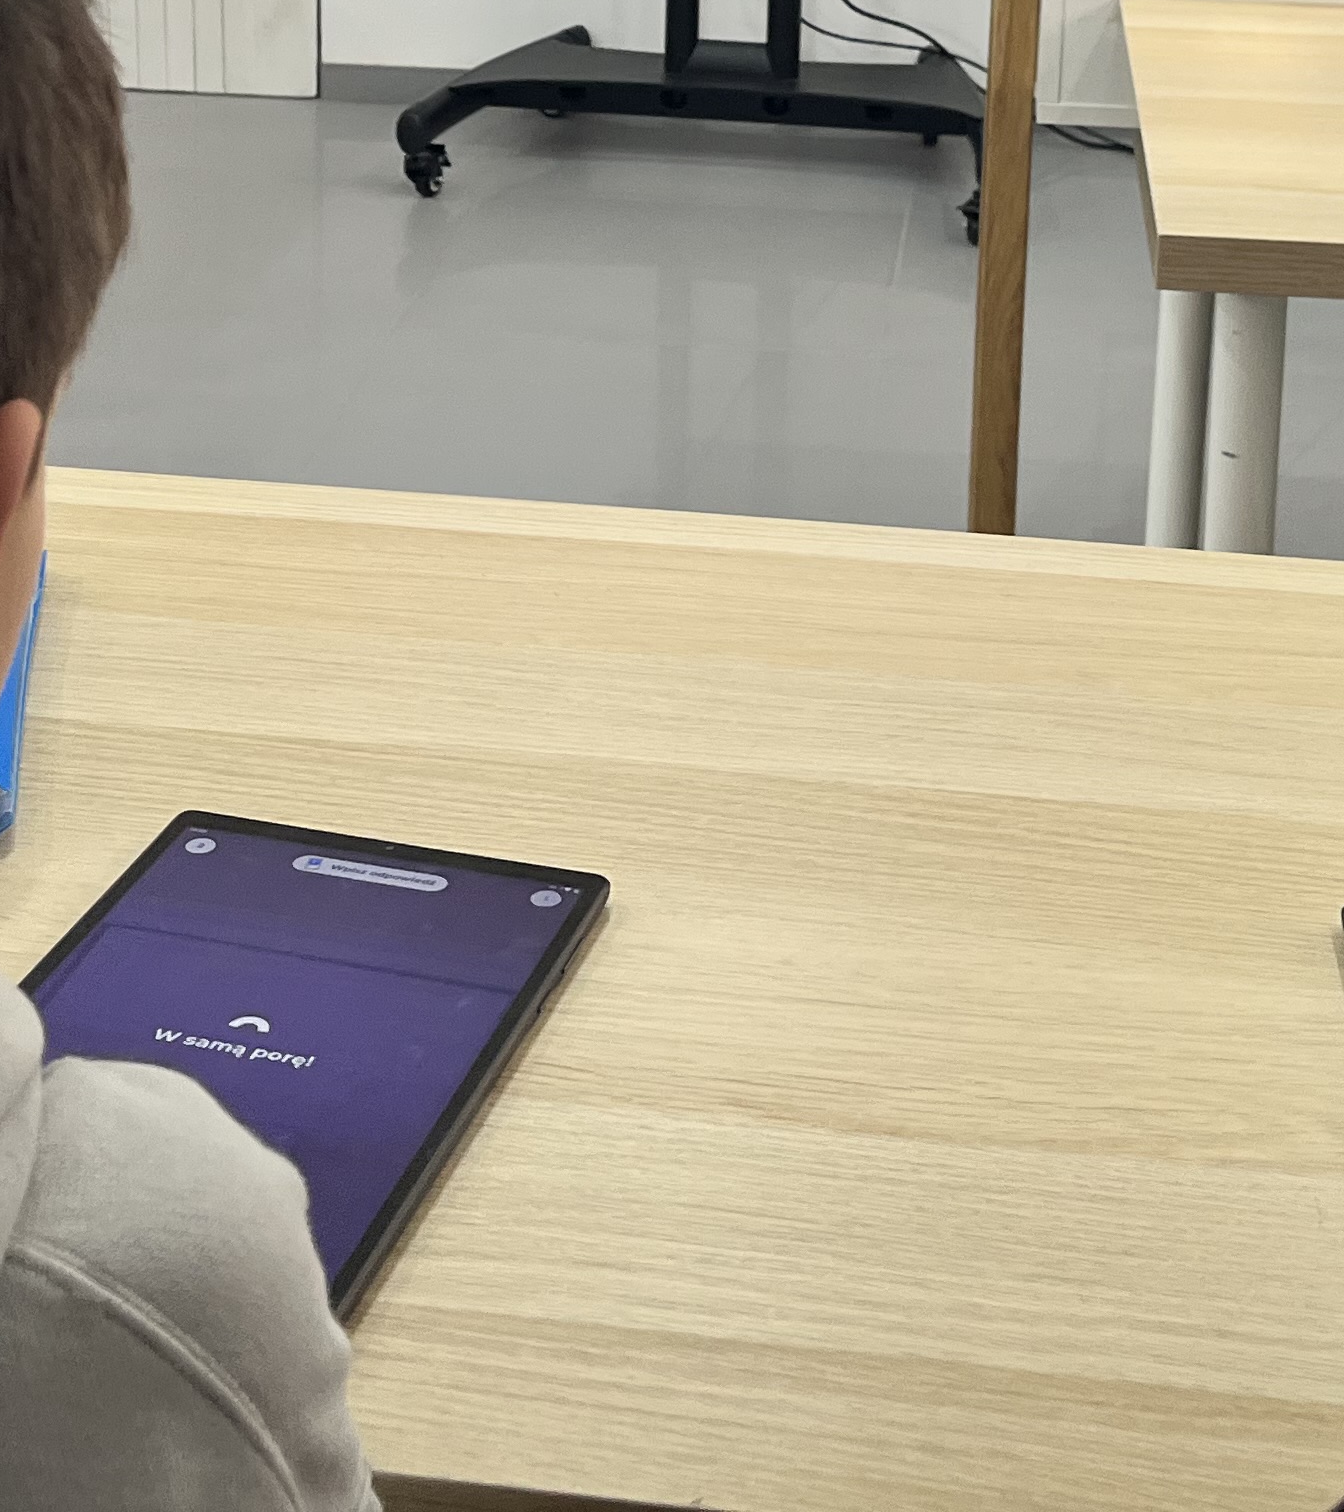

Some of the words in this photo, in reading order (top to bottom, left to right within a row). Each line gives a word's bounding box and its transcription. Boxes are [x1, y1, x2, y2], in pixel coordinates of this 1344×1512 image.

[155, 1028, 182, 1042] W
[183, 1036, 246, 1058] samą
[249, 1048, 316, 1069] porę!
